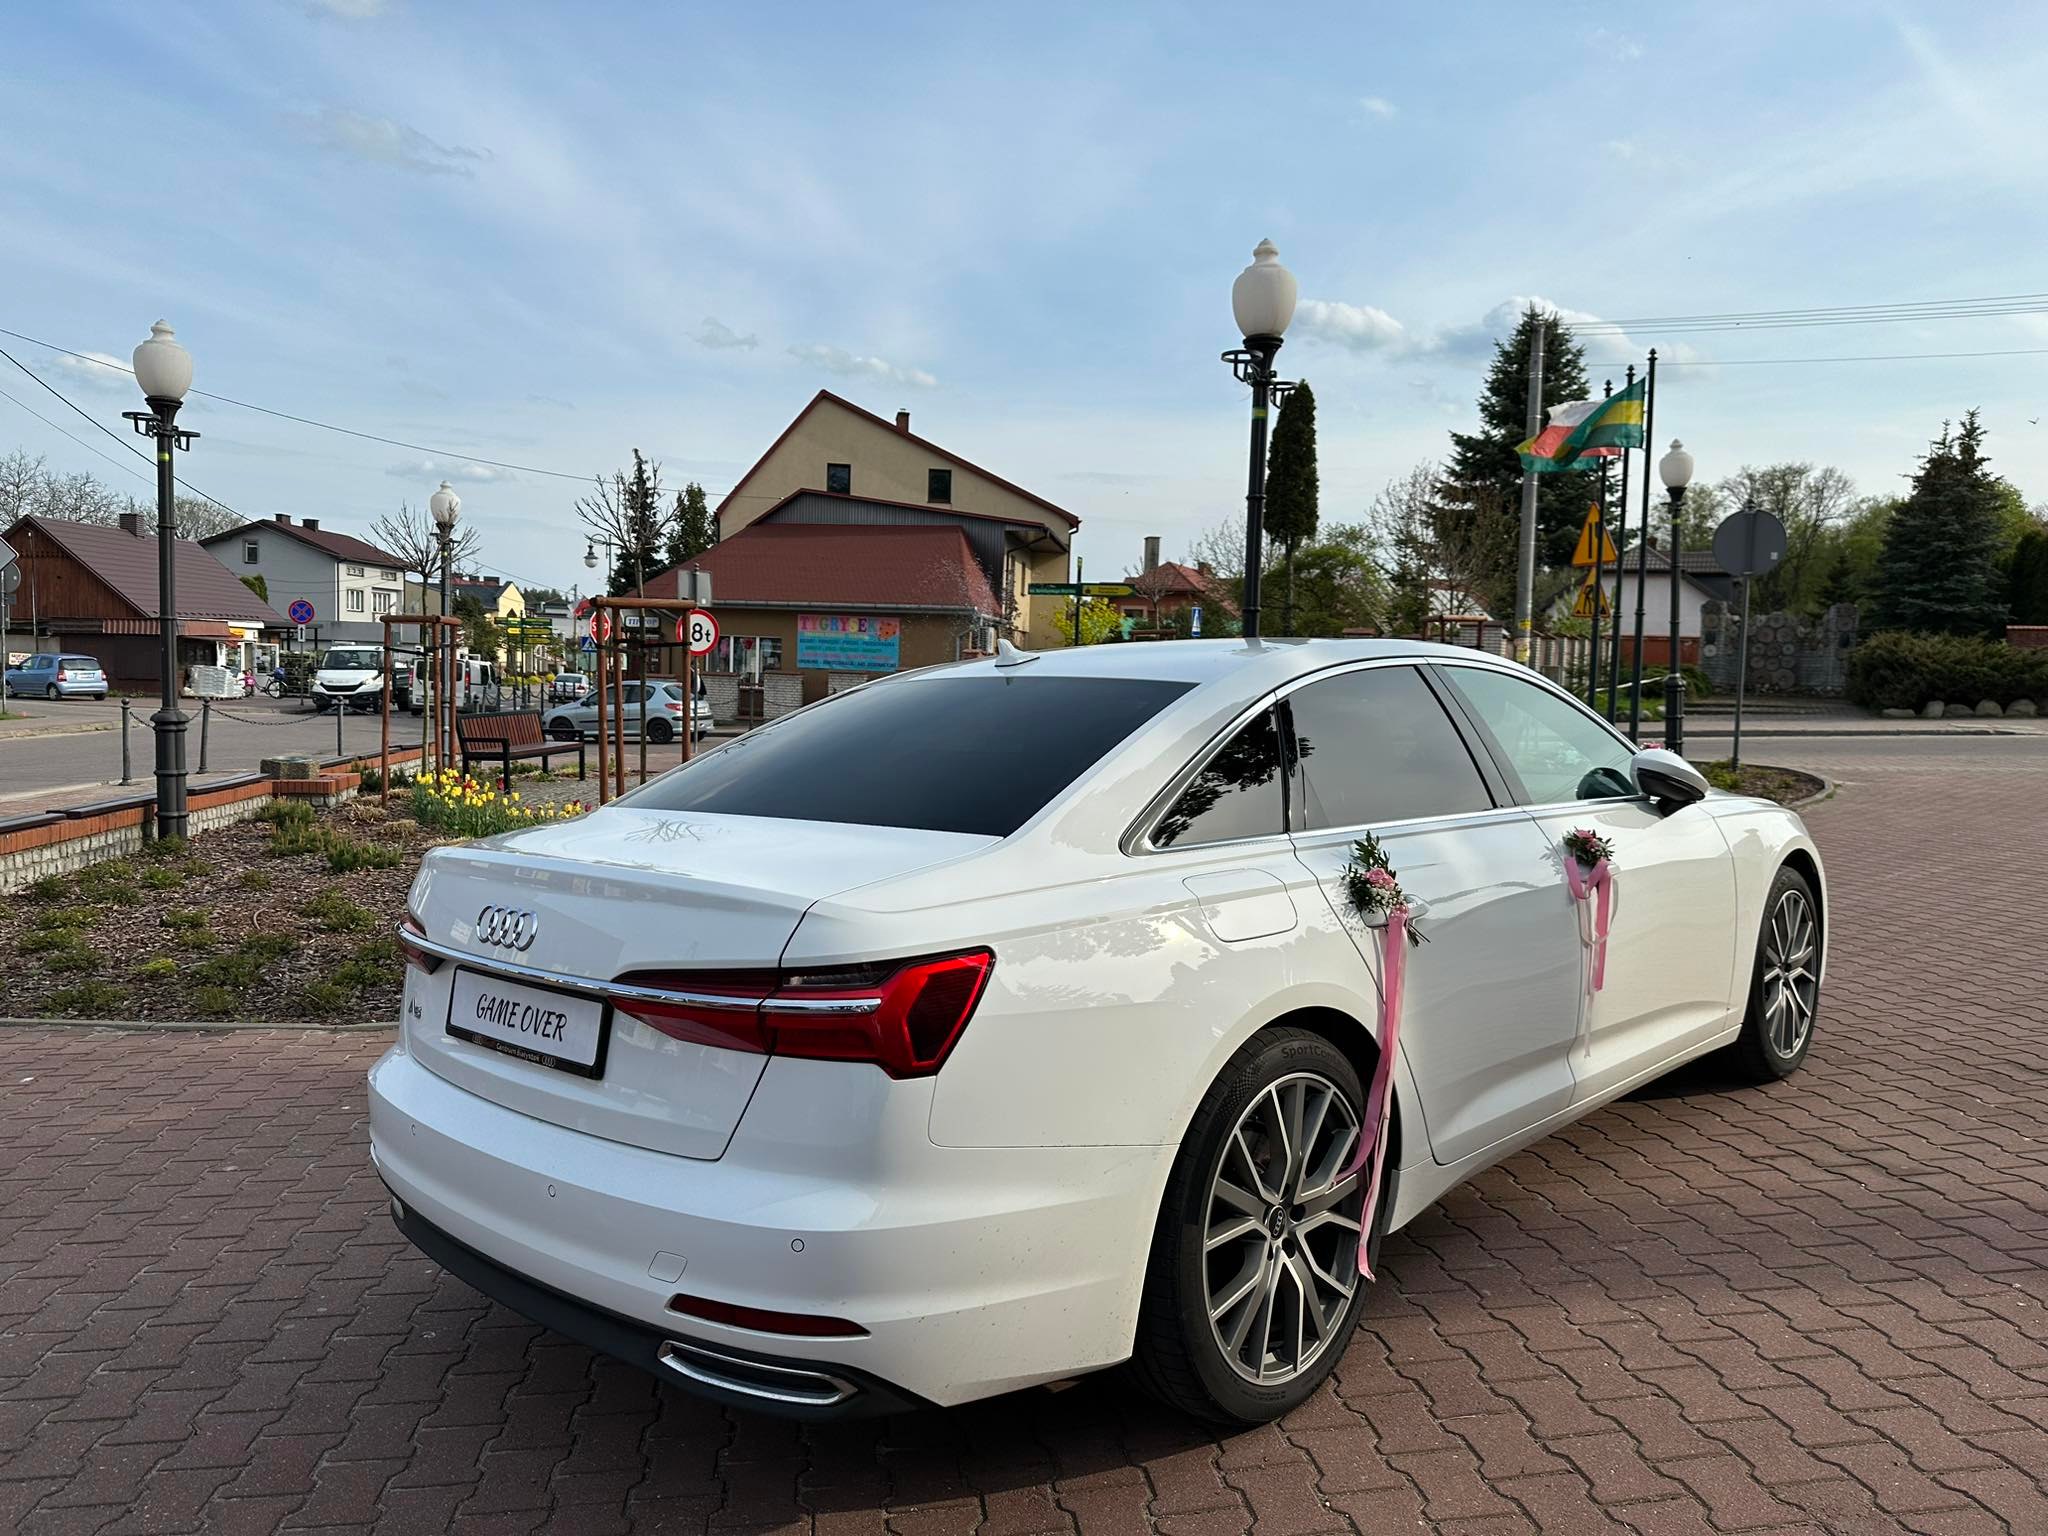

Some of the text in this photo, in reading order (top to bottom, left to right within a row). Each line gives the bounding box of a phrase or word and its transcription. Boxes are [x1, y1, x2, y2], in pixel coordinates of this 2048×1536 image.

[592, 621, 608, 632] SP
[800, 615, 877, 632] TYGRYSEK
[476, 993, 568, 1042] GAME OVER
